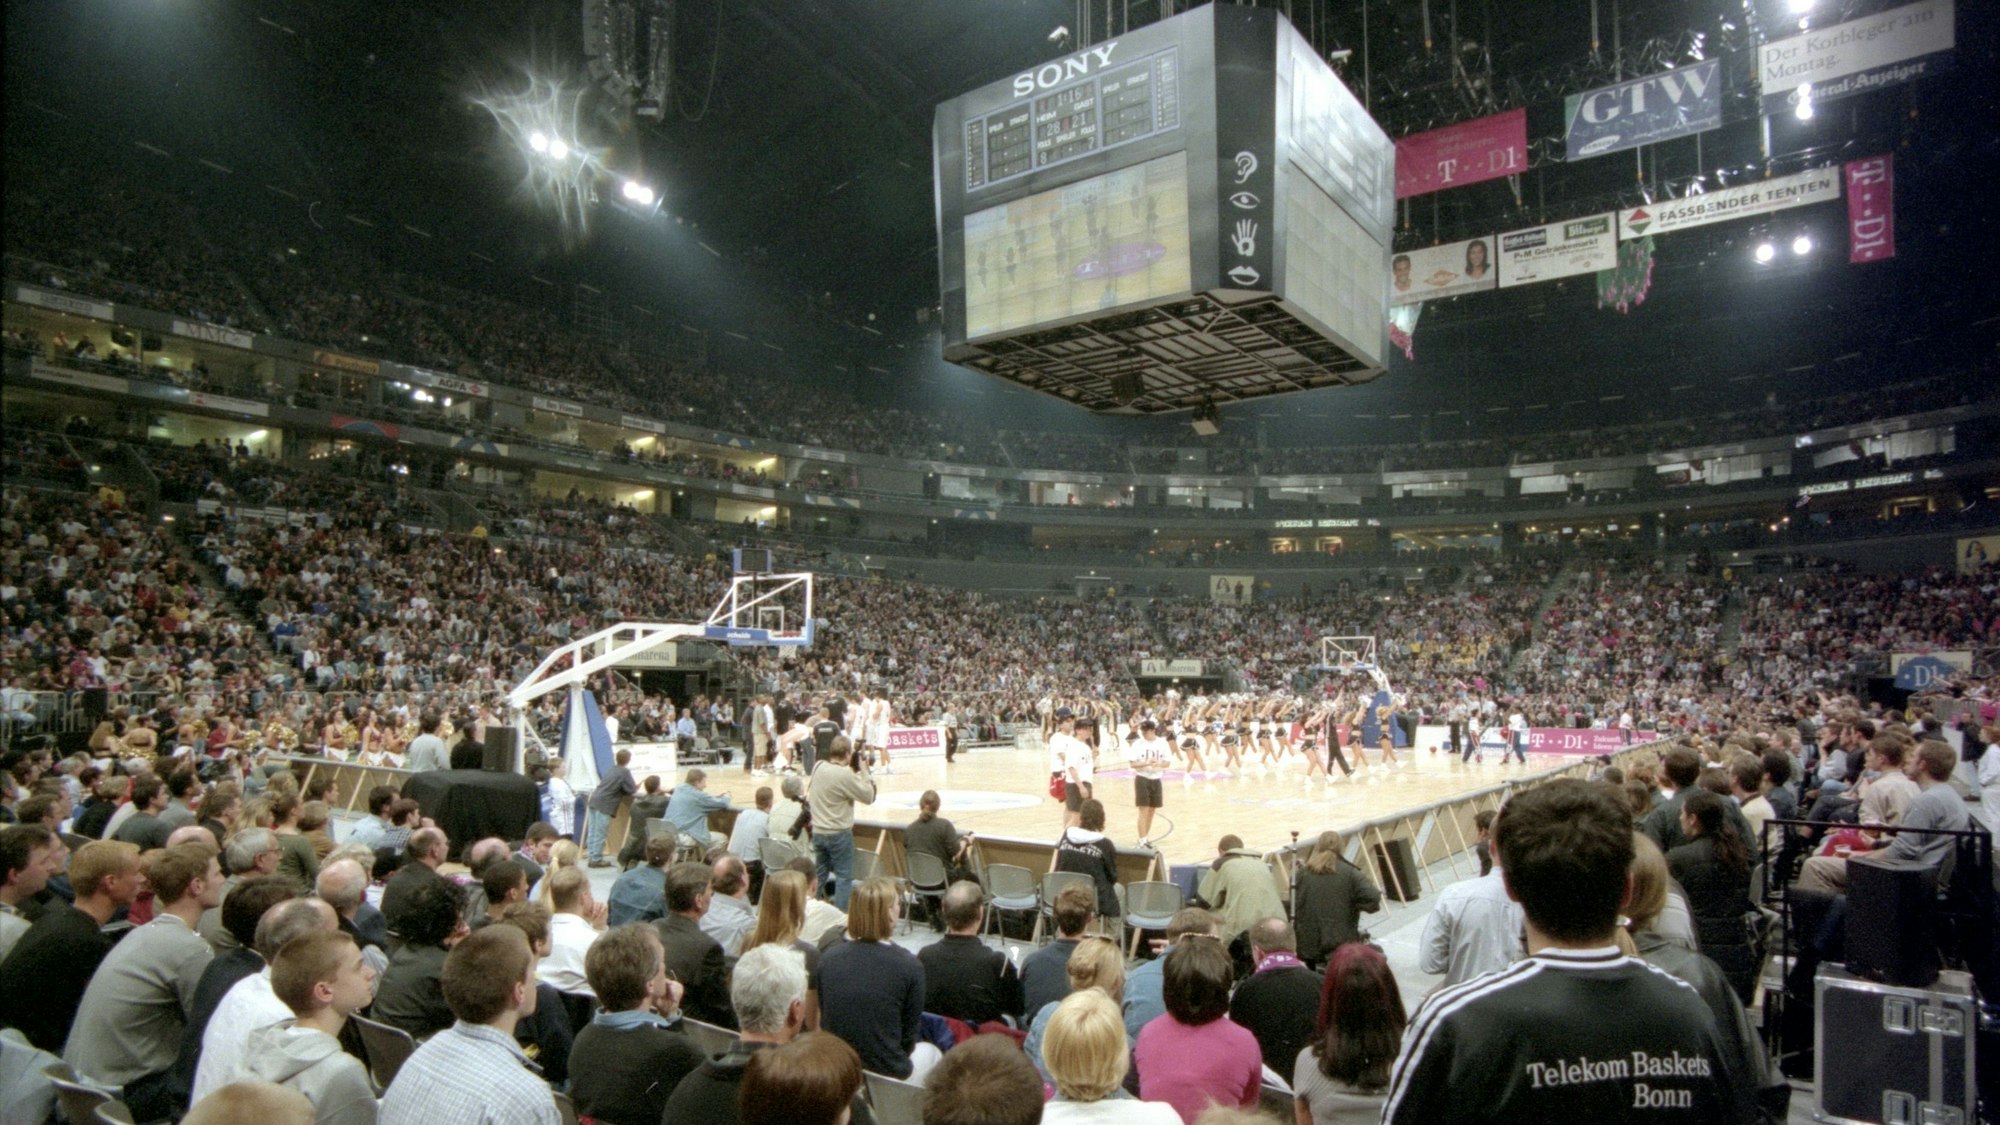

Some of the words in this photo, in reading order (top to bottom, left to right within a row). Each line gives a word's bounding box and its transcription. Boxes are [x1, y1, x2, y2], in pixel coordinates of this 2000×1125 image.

[1766, 47, 1797, 65] Der
[1806, 17, 1896, 53] Korbleger
[1904, 9, 1934, 26] am
[1013, 42, 1118, 98] SONY
[1787, 61, 1927, 105] Gneral-Anzeiger
[1036, 111, 1057, 123] HEIM
[1074, 97, 1094, 111] GAST
[1582, 62, 1719, 123] GTW
[1047, 121, 1060, 136] 28
[1072, 112, 1086, 128] 21
[1040, 151, 1047, 165] 8
[1659, 193, 1760, 222] FASSBENDER
[1767, 178, 1831, 201] TENTEN
[438, 378, 467, 393] AGFA
[1526, 1056, 1630, 1089] Telekom
[1631, 1051, 1711, 1077] Baskets
[1632, 1083, 1693, 1108] Bonn
